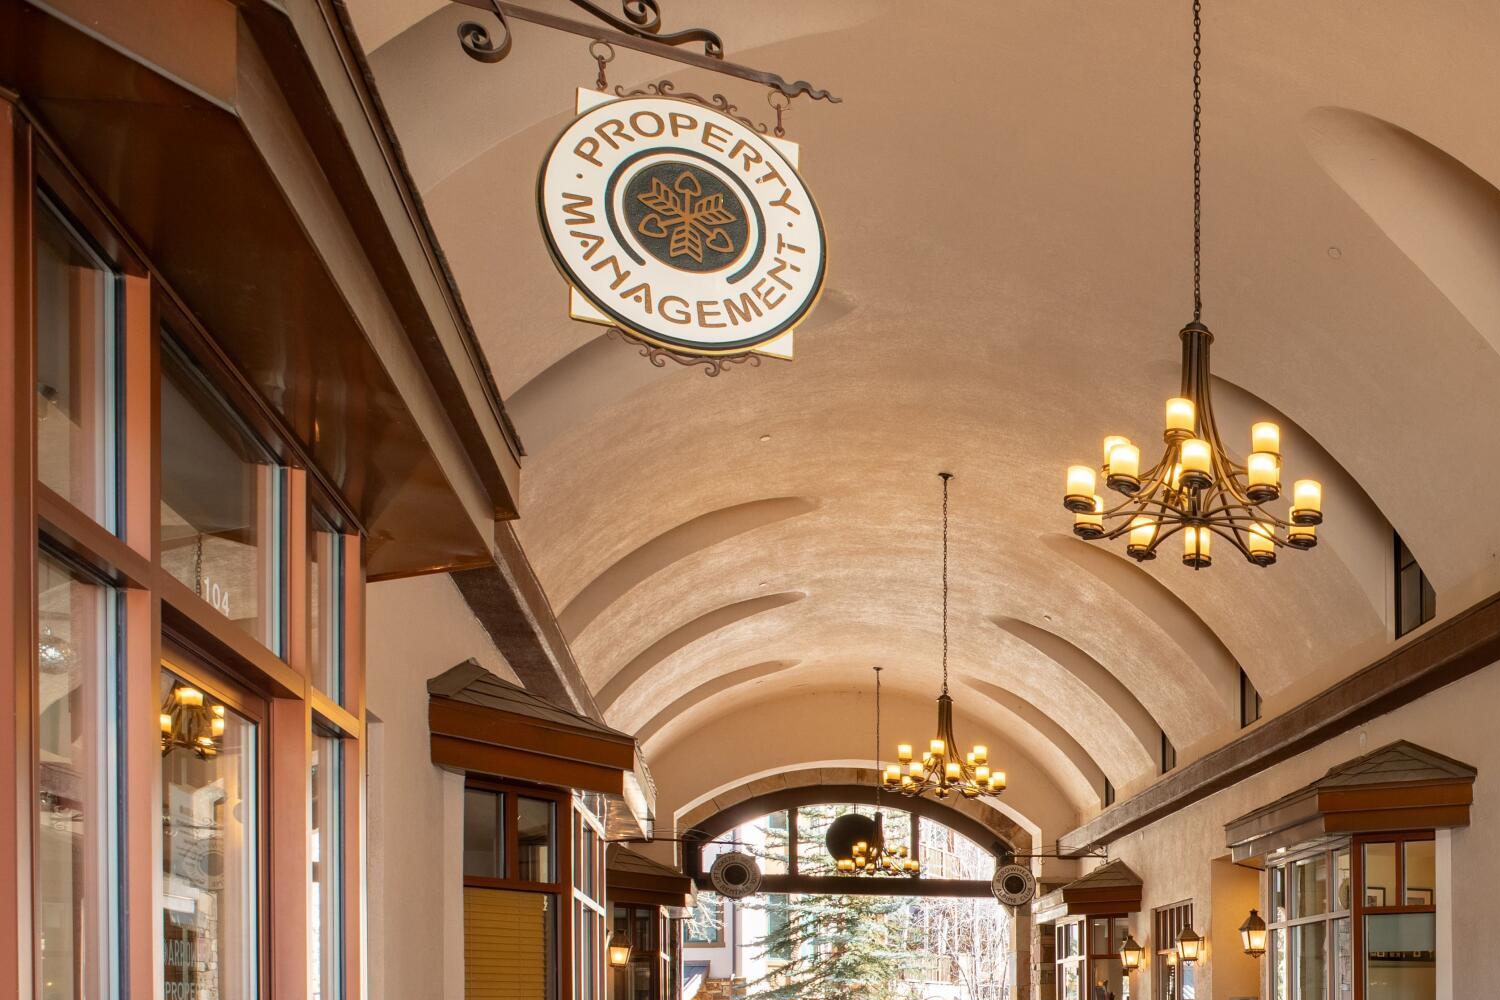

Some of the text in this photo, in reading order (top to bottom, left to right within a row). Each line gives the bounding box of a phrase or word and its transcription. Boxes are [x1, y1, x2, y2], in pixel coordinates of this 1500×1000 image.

[573, 110, 801, 216] PROPERTY
[561, 192, 806, 328] MANAGEMENT
[203, 576, 230, 617] 104
[996, 867, 1032, 883] ARROWHEAD
